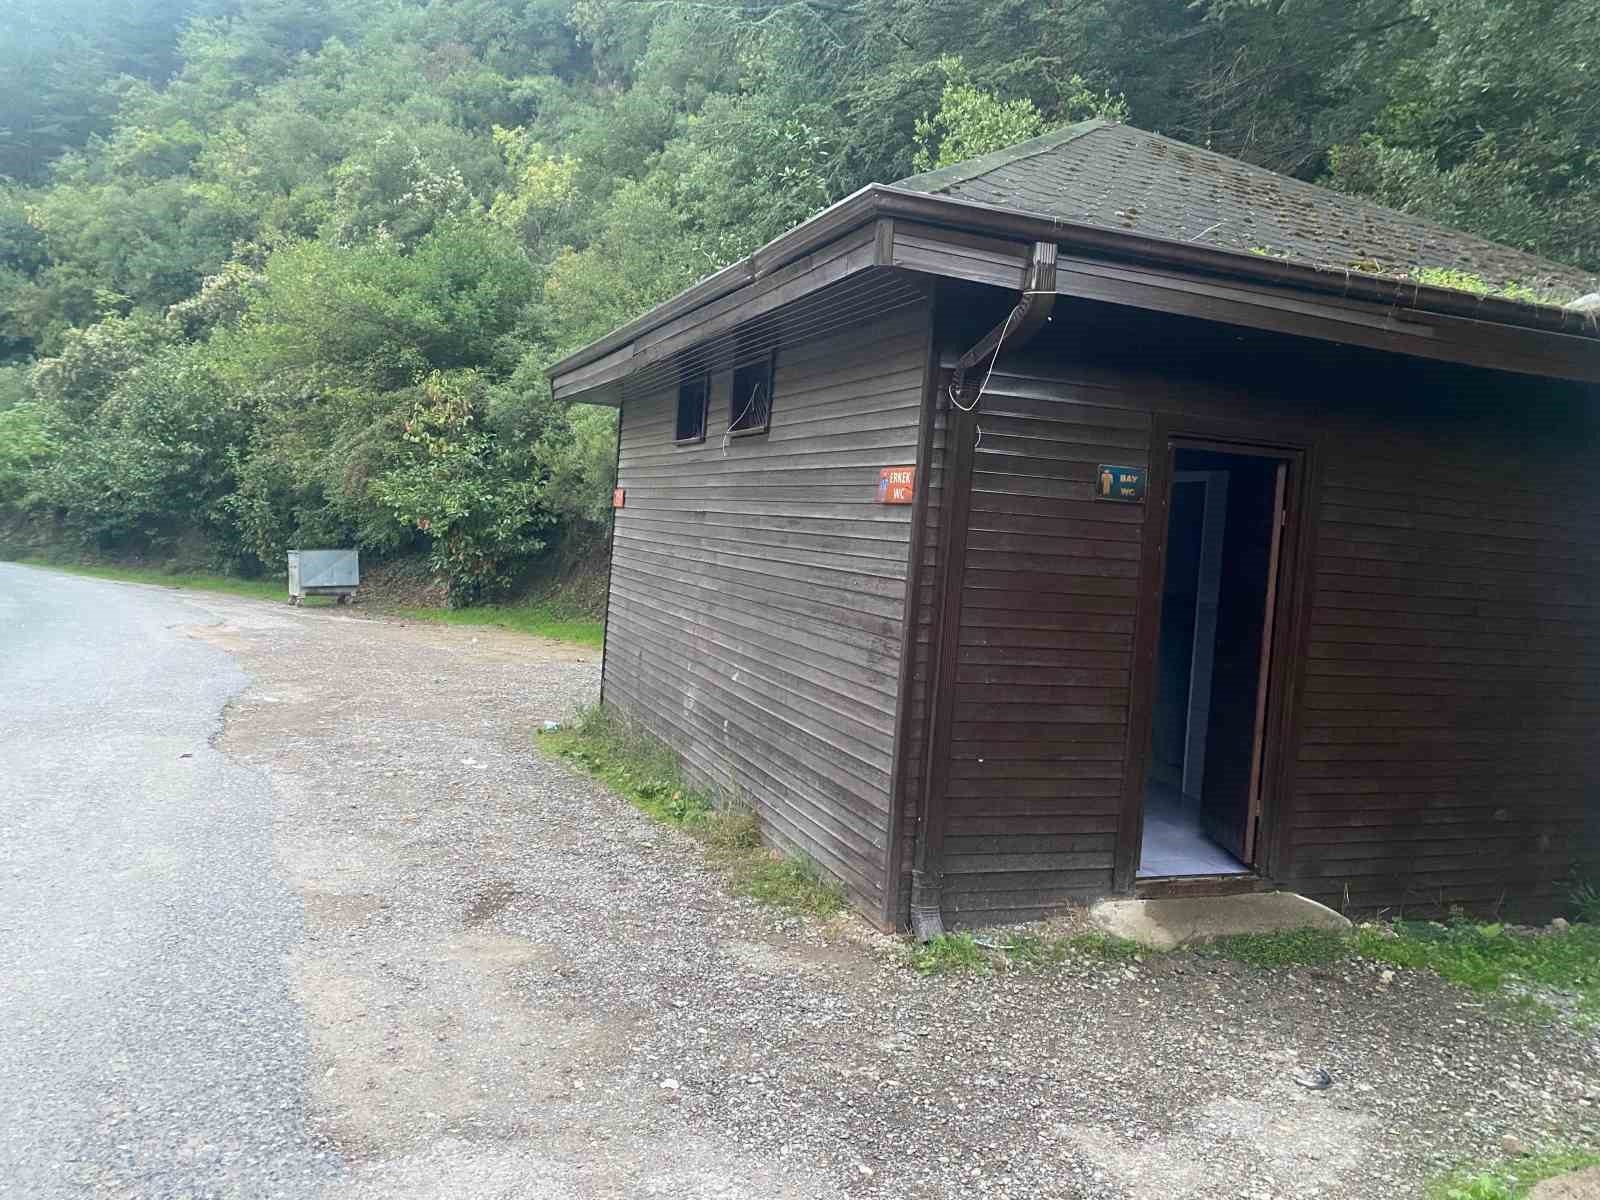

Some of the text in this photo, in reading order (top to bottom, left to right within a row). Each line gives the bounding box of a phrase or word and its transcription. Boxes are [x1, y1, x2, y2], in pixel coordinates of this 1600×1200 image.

[889, 471, 912, 484] ERKEK
[1120, 474, 1138, 483] BAY
[893, 487, 904, 499] WC
[1120, 487, 1136, 497] WC
